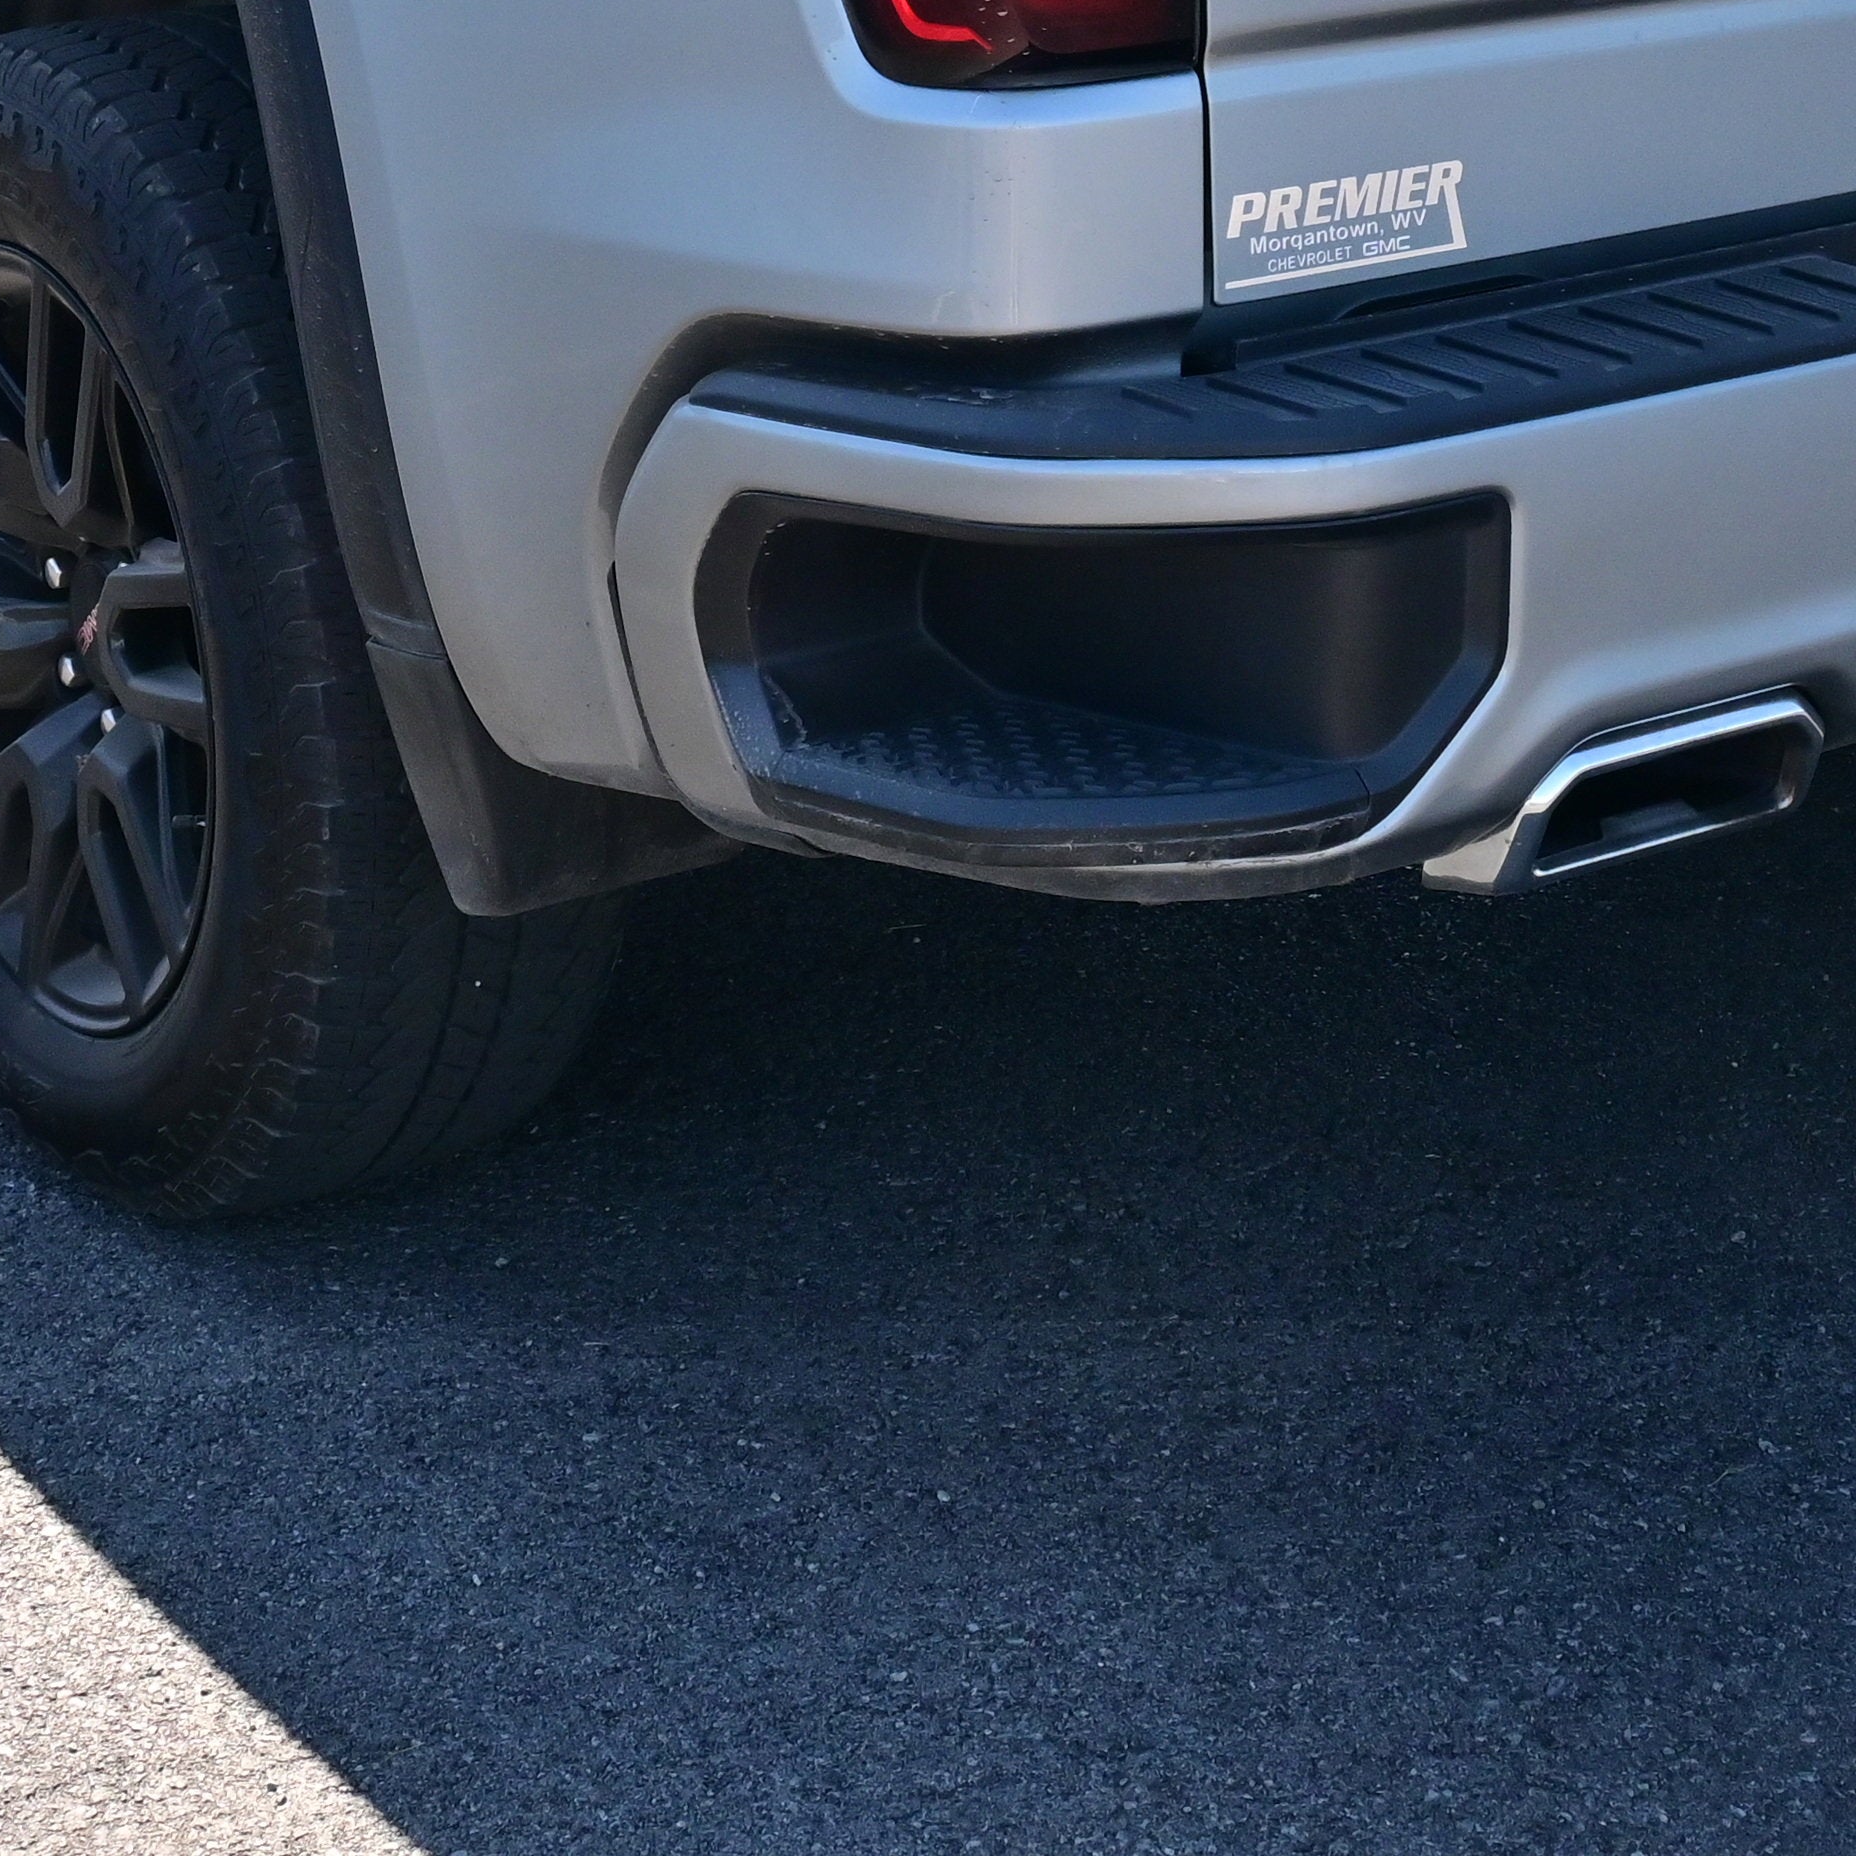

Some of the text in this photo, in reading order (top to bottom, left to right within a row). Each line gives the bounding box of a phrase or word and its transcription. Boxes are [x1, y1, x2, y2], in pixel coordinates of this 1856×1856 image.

[1226, 159, 1465, 240] PREMIER
[1250, 208, 1427, 256] Morgantown, WV
[1267, 235, 1411, 273] CHEVROLET GMC
